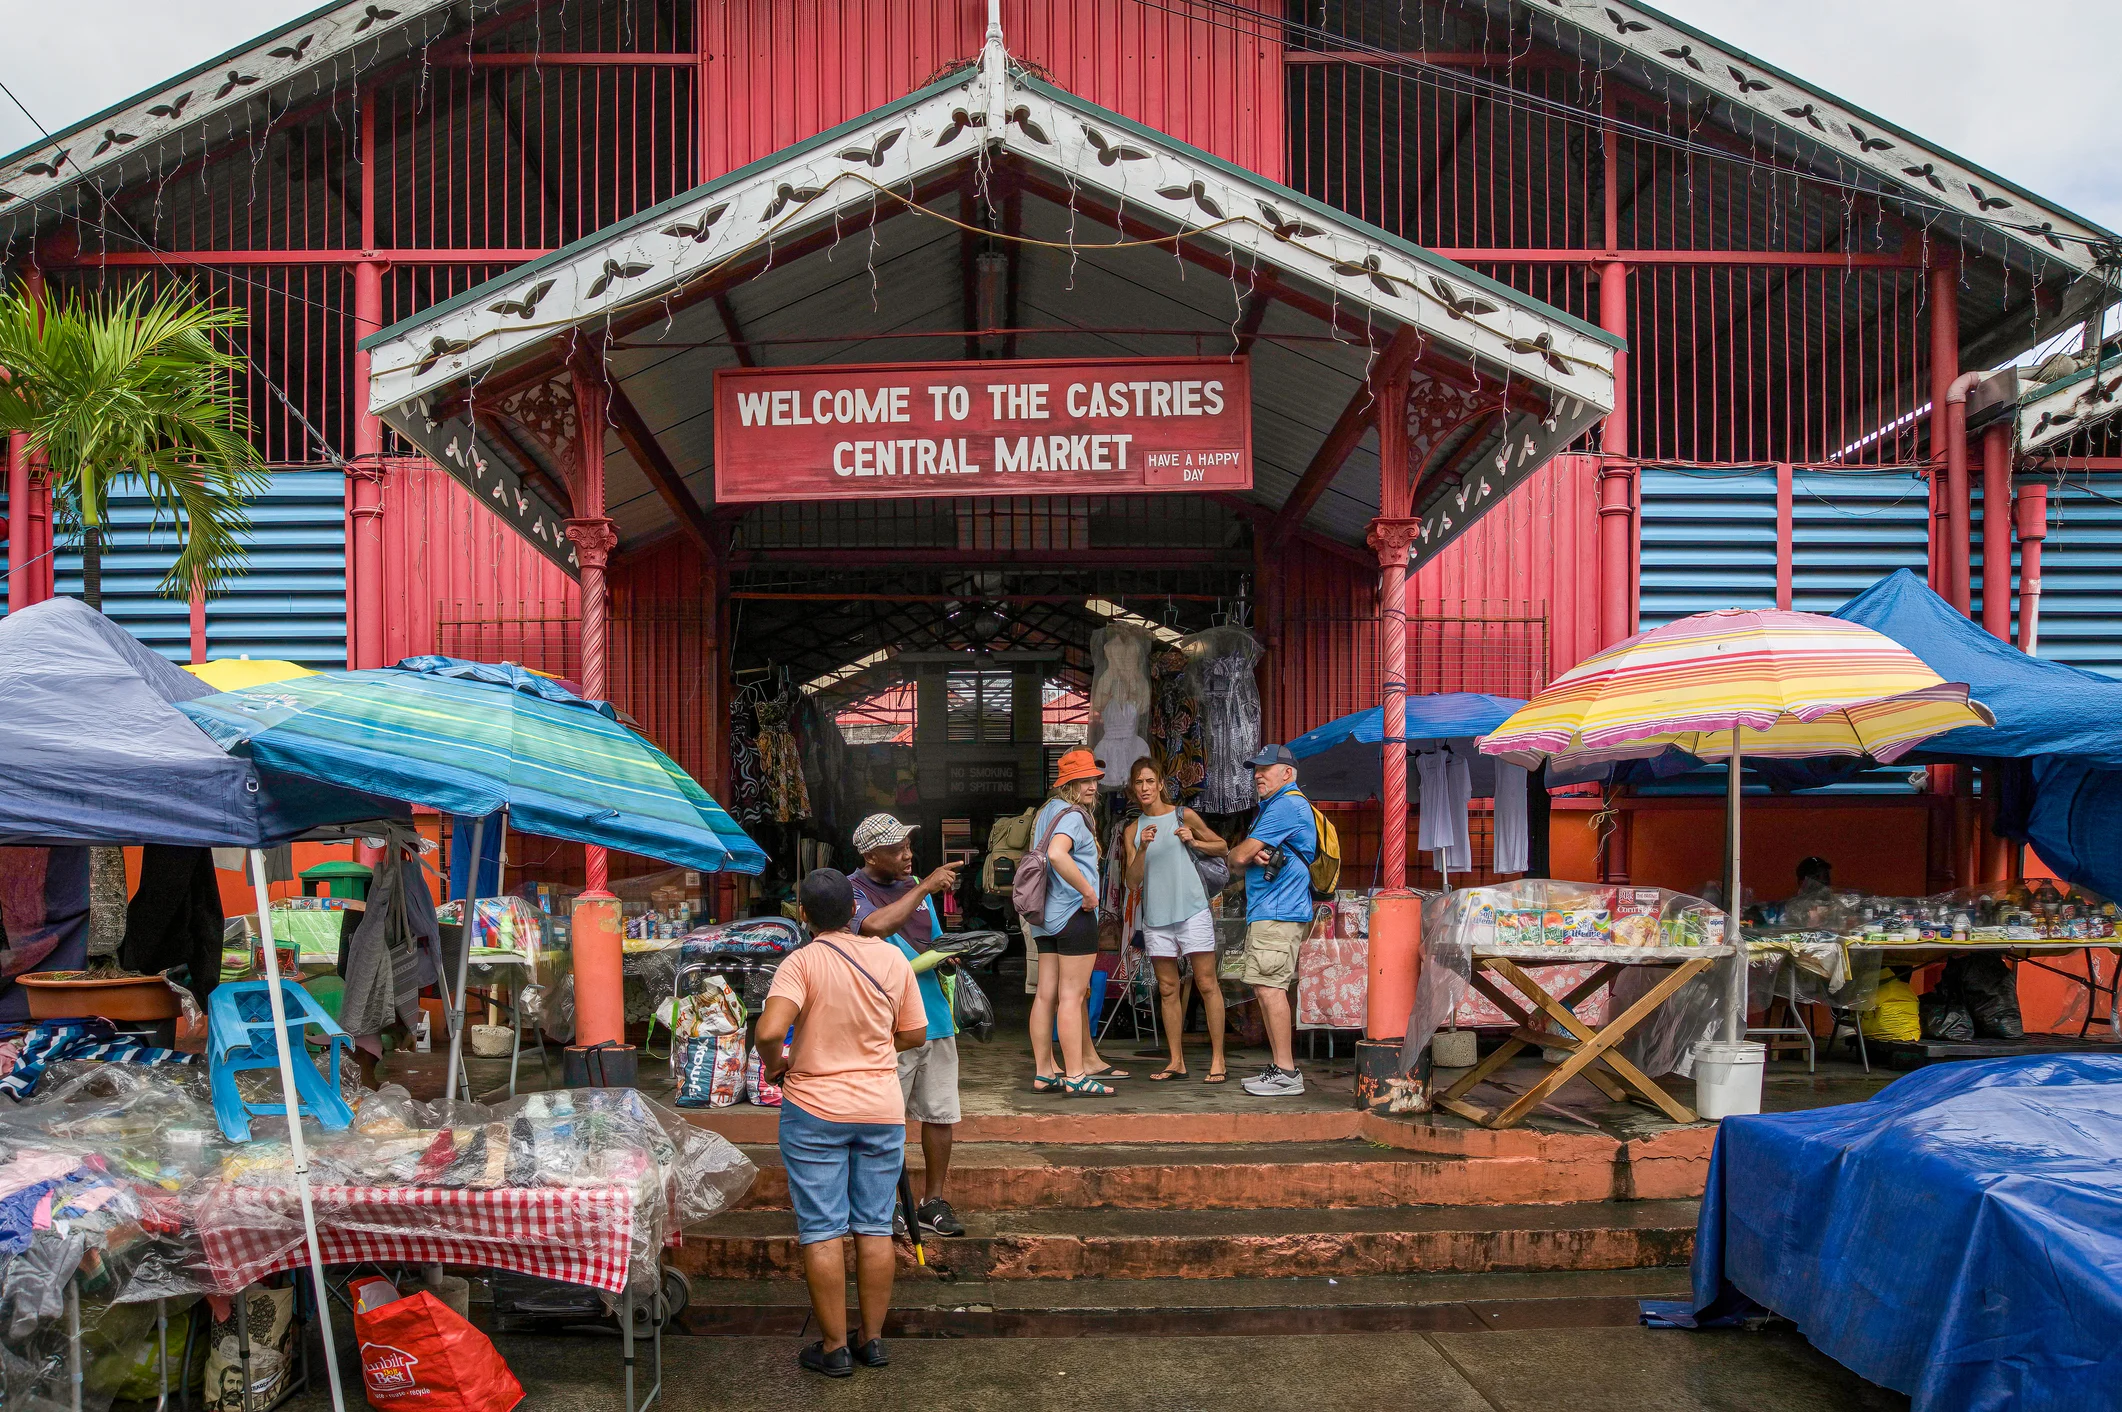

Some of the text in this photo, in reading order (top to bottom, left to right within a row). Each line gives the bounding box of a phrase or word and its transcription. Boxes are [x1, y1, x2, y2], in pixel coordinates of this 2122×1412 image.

[738, 380, 1224, 427] WELCOME TO THE CASTRIES
[833, 434, 1133, 477] CENTRAL MARKET
[1148, 452, 1240, 468] HAVE A HAPPY
[1183, 468, 1205, 482] DAY
[950, 767, 1013, 778] NO SMOKING
[950, 781, 1014, 792] NO SPITTING
[1709, 919, 1724, 927] alpro
[1572, 929, 1601, 938] Weave
[373, 1371, 407, 1384] Best
[409, 1387, 431, 1397] recycle
